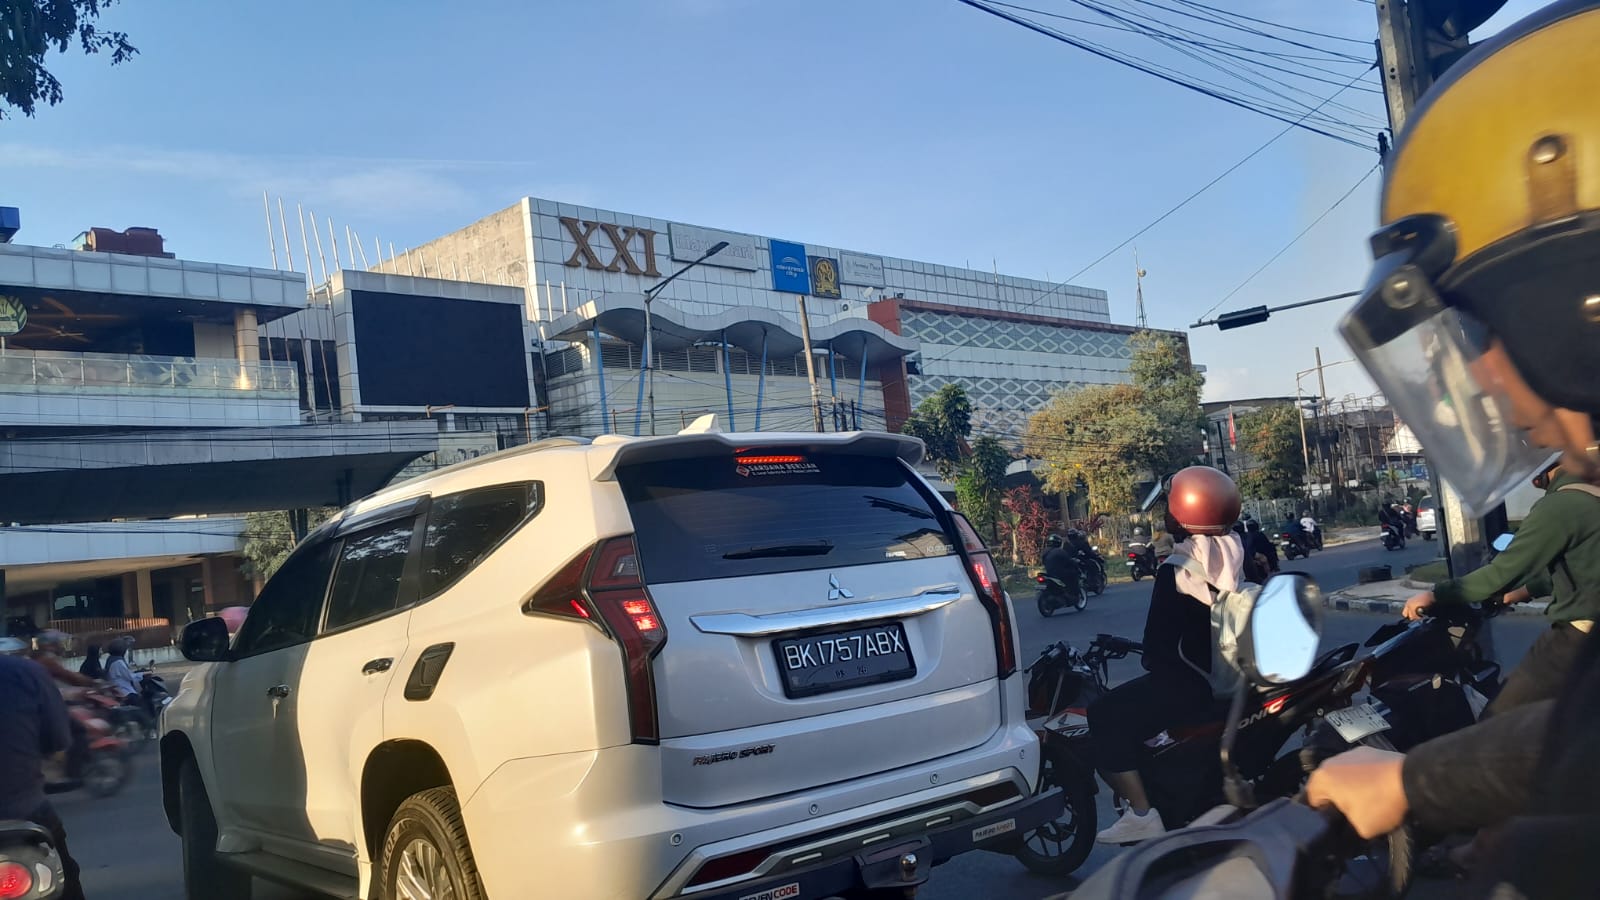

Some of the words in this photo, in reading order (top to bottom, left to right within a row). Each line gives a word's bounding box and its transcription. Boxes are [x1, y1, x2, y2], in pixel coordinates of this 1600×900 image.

[559, 216, 663, 278] XXI
[693, 750, 738, 766] PAJERO
[738, 743, 777, 759] SPORT
